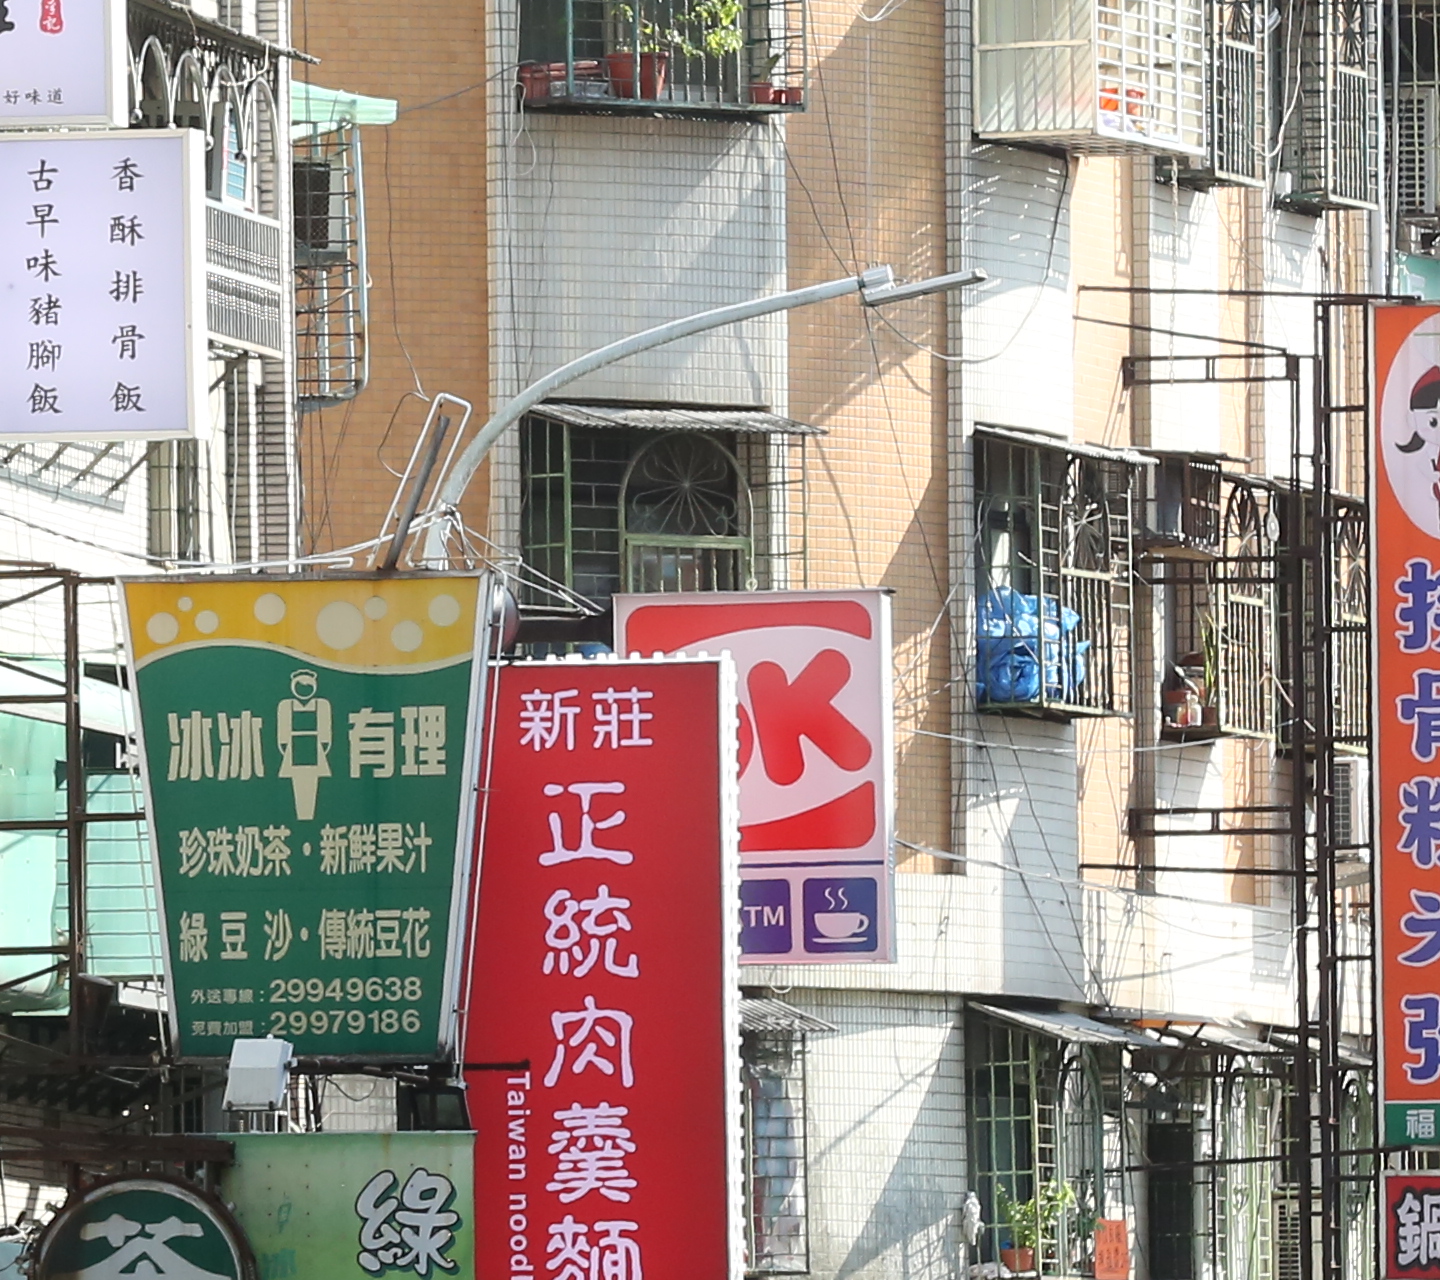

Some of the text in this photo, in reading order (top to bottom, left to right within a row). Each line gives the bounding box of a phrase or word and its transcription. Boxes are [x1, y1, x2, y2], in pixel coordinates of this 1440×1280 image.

[108, 159, 146, 415] 香酥排骨飯
[521, 687, 654, 751] 新莊
[736, 648, 872, 786] K
[269, 977, 422, 1004] 29949638
[269, 1010, 421, 1036] 29979186
[506, 1072, 531, 1180] Taiwan
